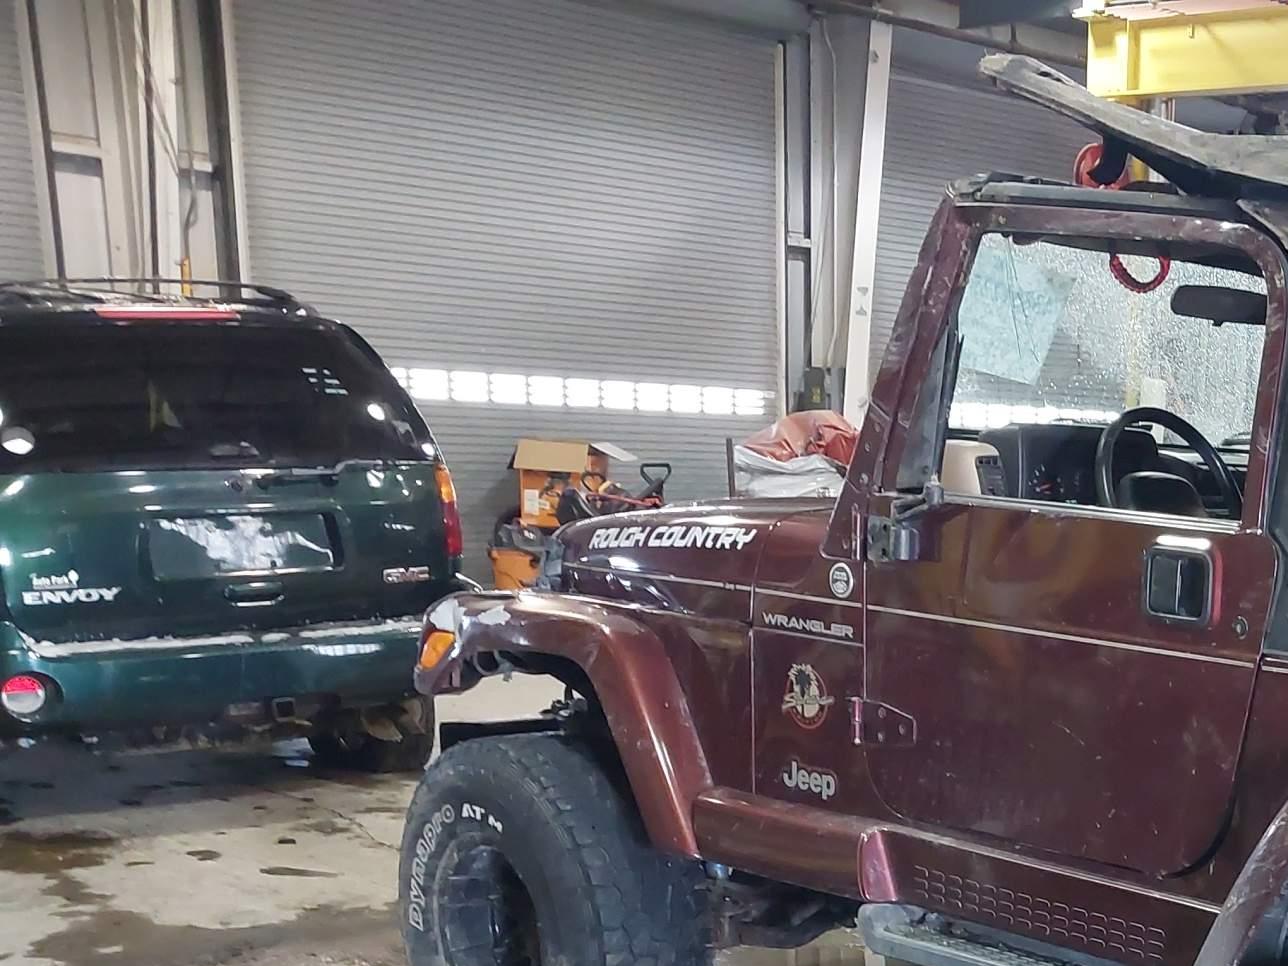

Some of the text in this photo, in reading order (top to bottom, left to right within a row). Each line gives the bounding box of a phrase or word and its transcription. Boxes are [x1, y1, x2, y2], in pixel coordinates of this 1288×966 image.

[588, 525, 757, 550] ROUGH COUNTRY
[21, 586, 122, 605] ENVOY
[762, 611, 854, 639] WRANGLER
[782, 760, 836, 800] Jeep
